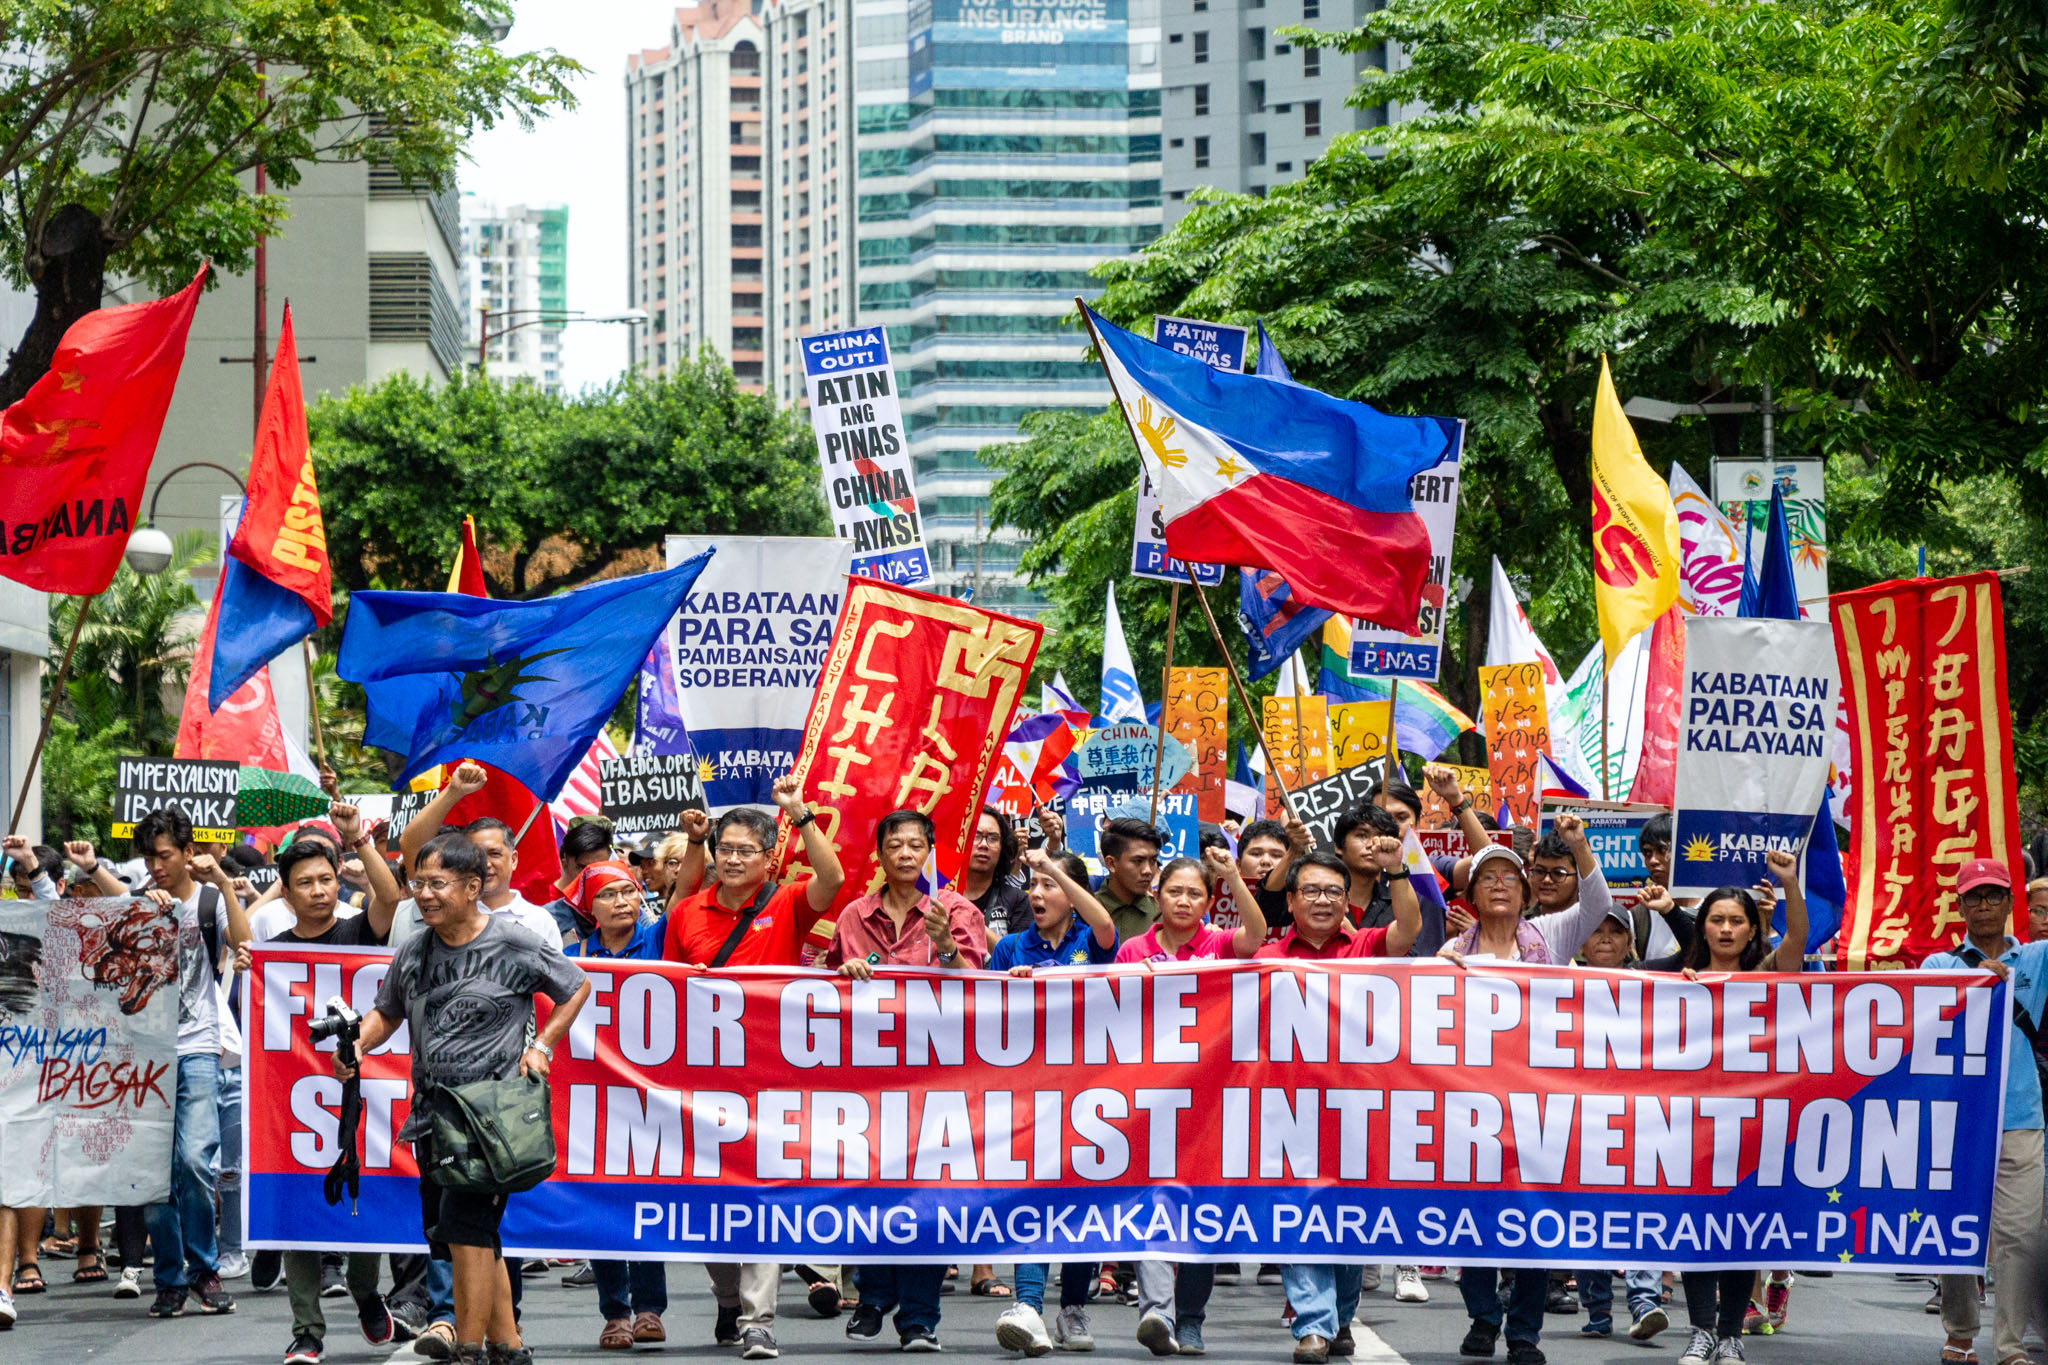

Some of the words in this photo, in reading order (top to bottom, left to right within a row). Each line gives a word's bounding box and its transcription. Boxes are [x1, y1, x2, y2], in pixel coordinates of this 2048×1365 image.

[958, 9, 1107, 30] INSURANCE
[1001, 30, 1064, 45] BRAND
[809, 333, 880, 354] CHINA
[1165, 323, 1217, 342] #ATIN
[1194, 341, 1219, 352] ANG
[820, 351, 874, 369] OUT!
[818, 370, 890, 407] ATIN
[840, 404, 875, 427] ANG
[825, 424, 900, 464] PINAS
[833, 468, 912, 509] CHINA
[1408, 474, 1454, 504] ERT
[680, 592, 839, 615] KABATAAN
[679, 618, 776, 645] PARA
[789, 618, 832, 646] SA
[680, 668, 822, 688] SOBERANY
[1691, 671, 1828, 699] KABATAAN
[1689, 698, 1778, 728] PARA
[1788, 702, 1825, 731] SA
[1101, 725, 1152, 742] CHINA,
[1687, 729, 1823, 757] KALAYAAN
[719, 750, 794, 768] KABATA
[120, 761, 239, 796] IMPERYALISMO
[602, 775, 701, 807] IBASURA
[1288, 757, 1387, 818] RESIST
[401, 794, 418, 809] NO
[424, 789, 439, 805] TO
[1422, 836, 1443, 853] ang
[1588, 835, 1636, 851] GHT
[263, 960, 412, 1056] FIG
[568, 971, 746, 1068] FOR
[779, 973, 1199, 1069] GENUINE
[1230, 971, 1993, 1077] INDEPENDENCE!
[37, 1056, 172, 1110] IBAGSAK
[566, 1084, 1193, 1182] IMPERIALIST
[1221, 1086, 1959, 1191] INTERVENTION!
[634, 1202, 918, 1245] PILIPINONG
[937, 1202, 1258, 1244] NAGKAKAISA
[1273, 1204, 1403, 1244] PARA
[1417, 1207, 1483, 1246] SA
